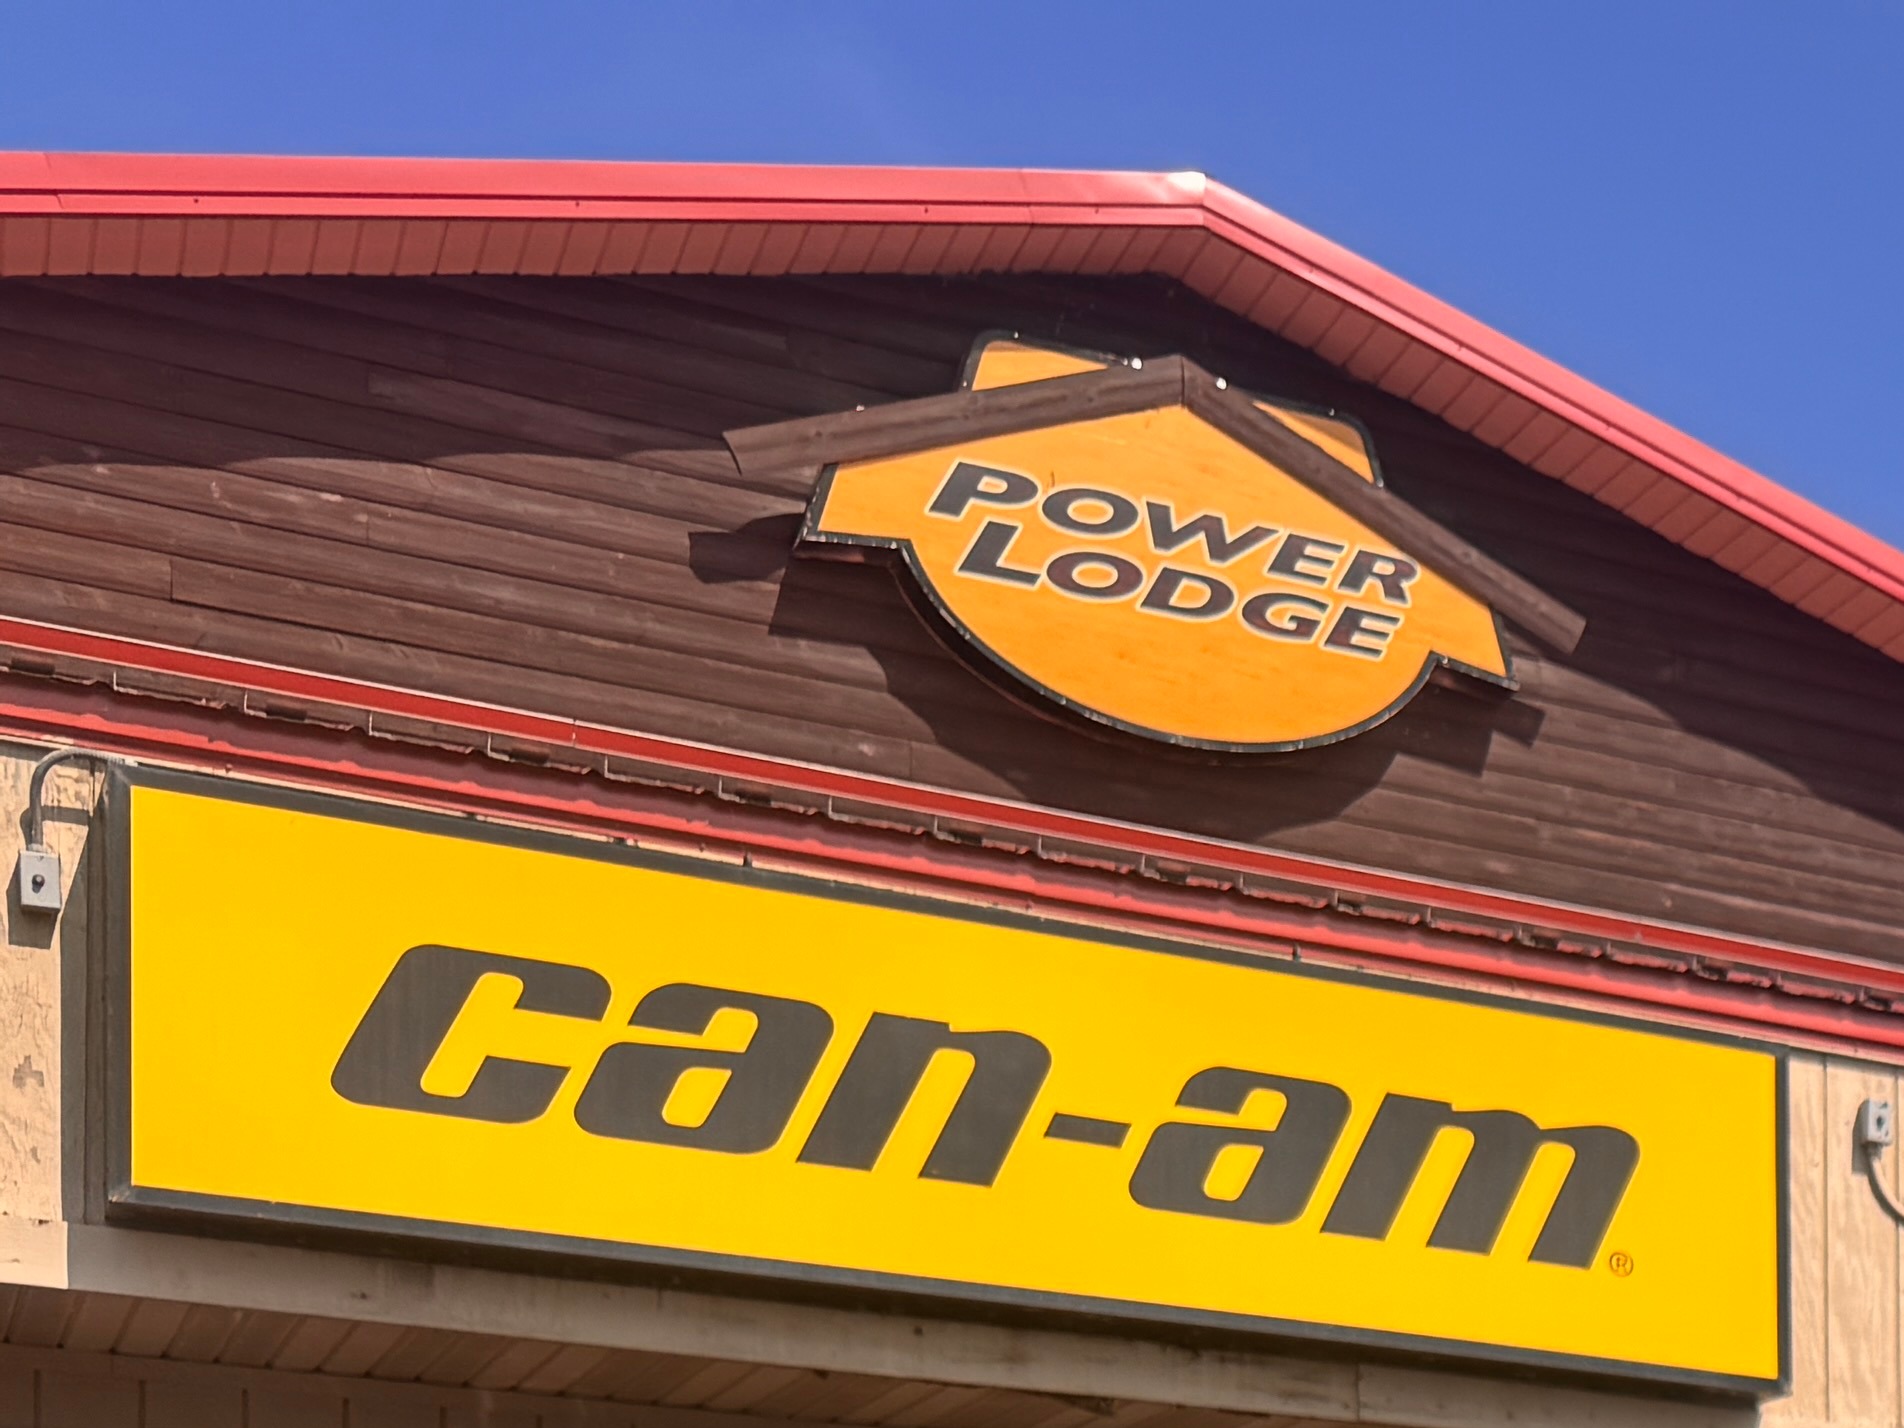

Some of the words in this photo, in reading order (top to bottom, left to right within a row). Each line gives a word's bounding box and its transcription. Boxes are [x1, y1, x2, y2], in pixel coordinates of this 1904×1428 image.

[927, 461, 1417, 606] POWER
[956, 519, 1402, 660] LODGE
[329, 943, 1641, 1271] can-am
